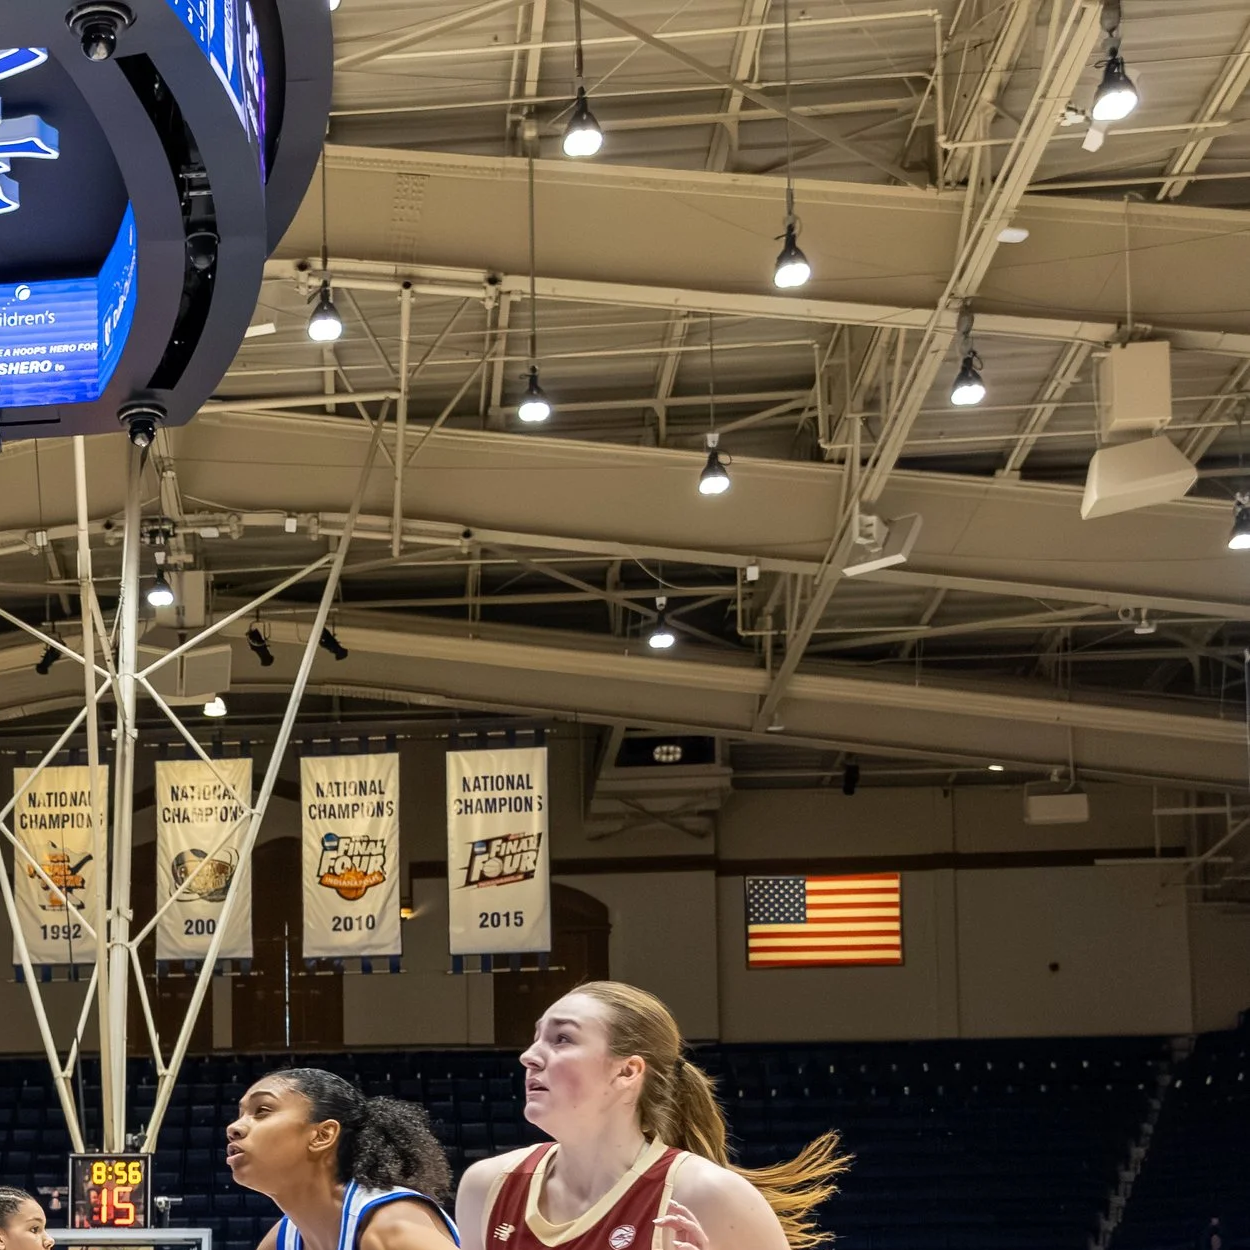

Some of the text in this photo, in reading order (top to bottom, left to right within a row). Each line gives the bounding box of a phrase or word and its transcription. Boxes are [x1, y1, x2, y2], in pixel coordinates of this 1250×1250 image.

[3, 348, 13, 357] A
[12, 346, 48, 356] HOOPS
[49, 344, 77, 354] HERO
[77, 342, 98, 352] FOR
[54, 363, 65, 372] to
[316, 779, 385, 798] NATIONAL
[462, 773, 533, 792] NATIONAL
[171, 784, 238, 801] NATIONAL
[162, 806, 245, 823] CHAMPIONS
[308, 801, 393, 820] CHAMPIONS
[454, 796, 542, 815] CHAMPIONS
[338, 837, 385, 856] FINAL
[490, 836, 540, 857] FINAL
[320, 850, 386, 877] FOUR
[471, 851, 537, 881] FOUR
[324, 873, 381, 887] INDIANAPOLIS
[184, 919, 216, 935] 200
[332, 915, 375, 932] 2010
[479, 911, 524, 928] 2015
[40, 924, 82, 940] 1992
[93, 1161, 142, 1185] 8:56
[101, 1187, 134, 1225] 15
